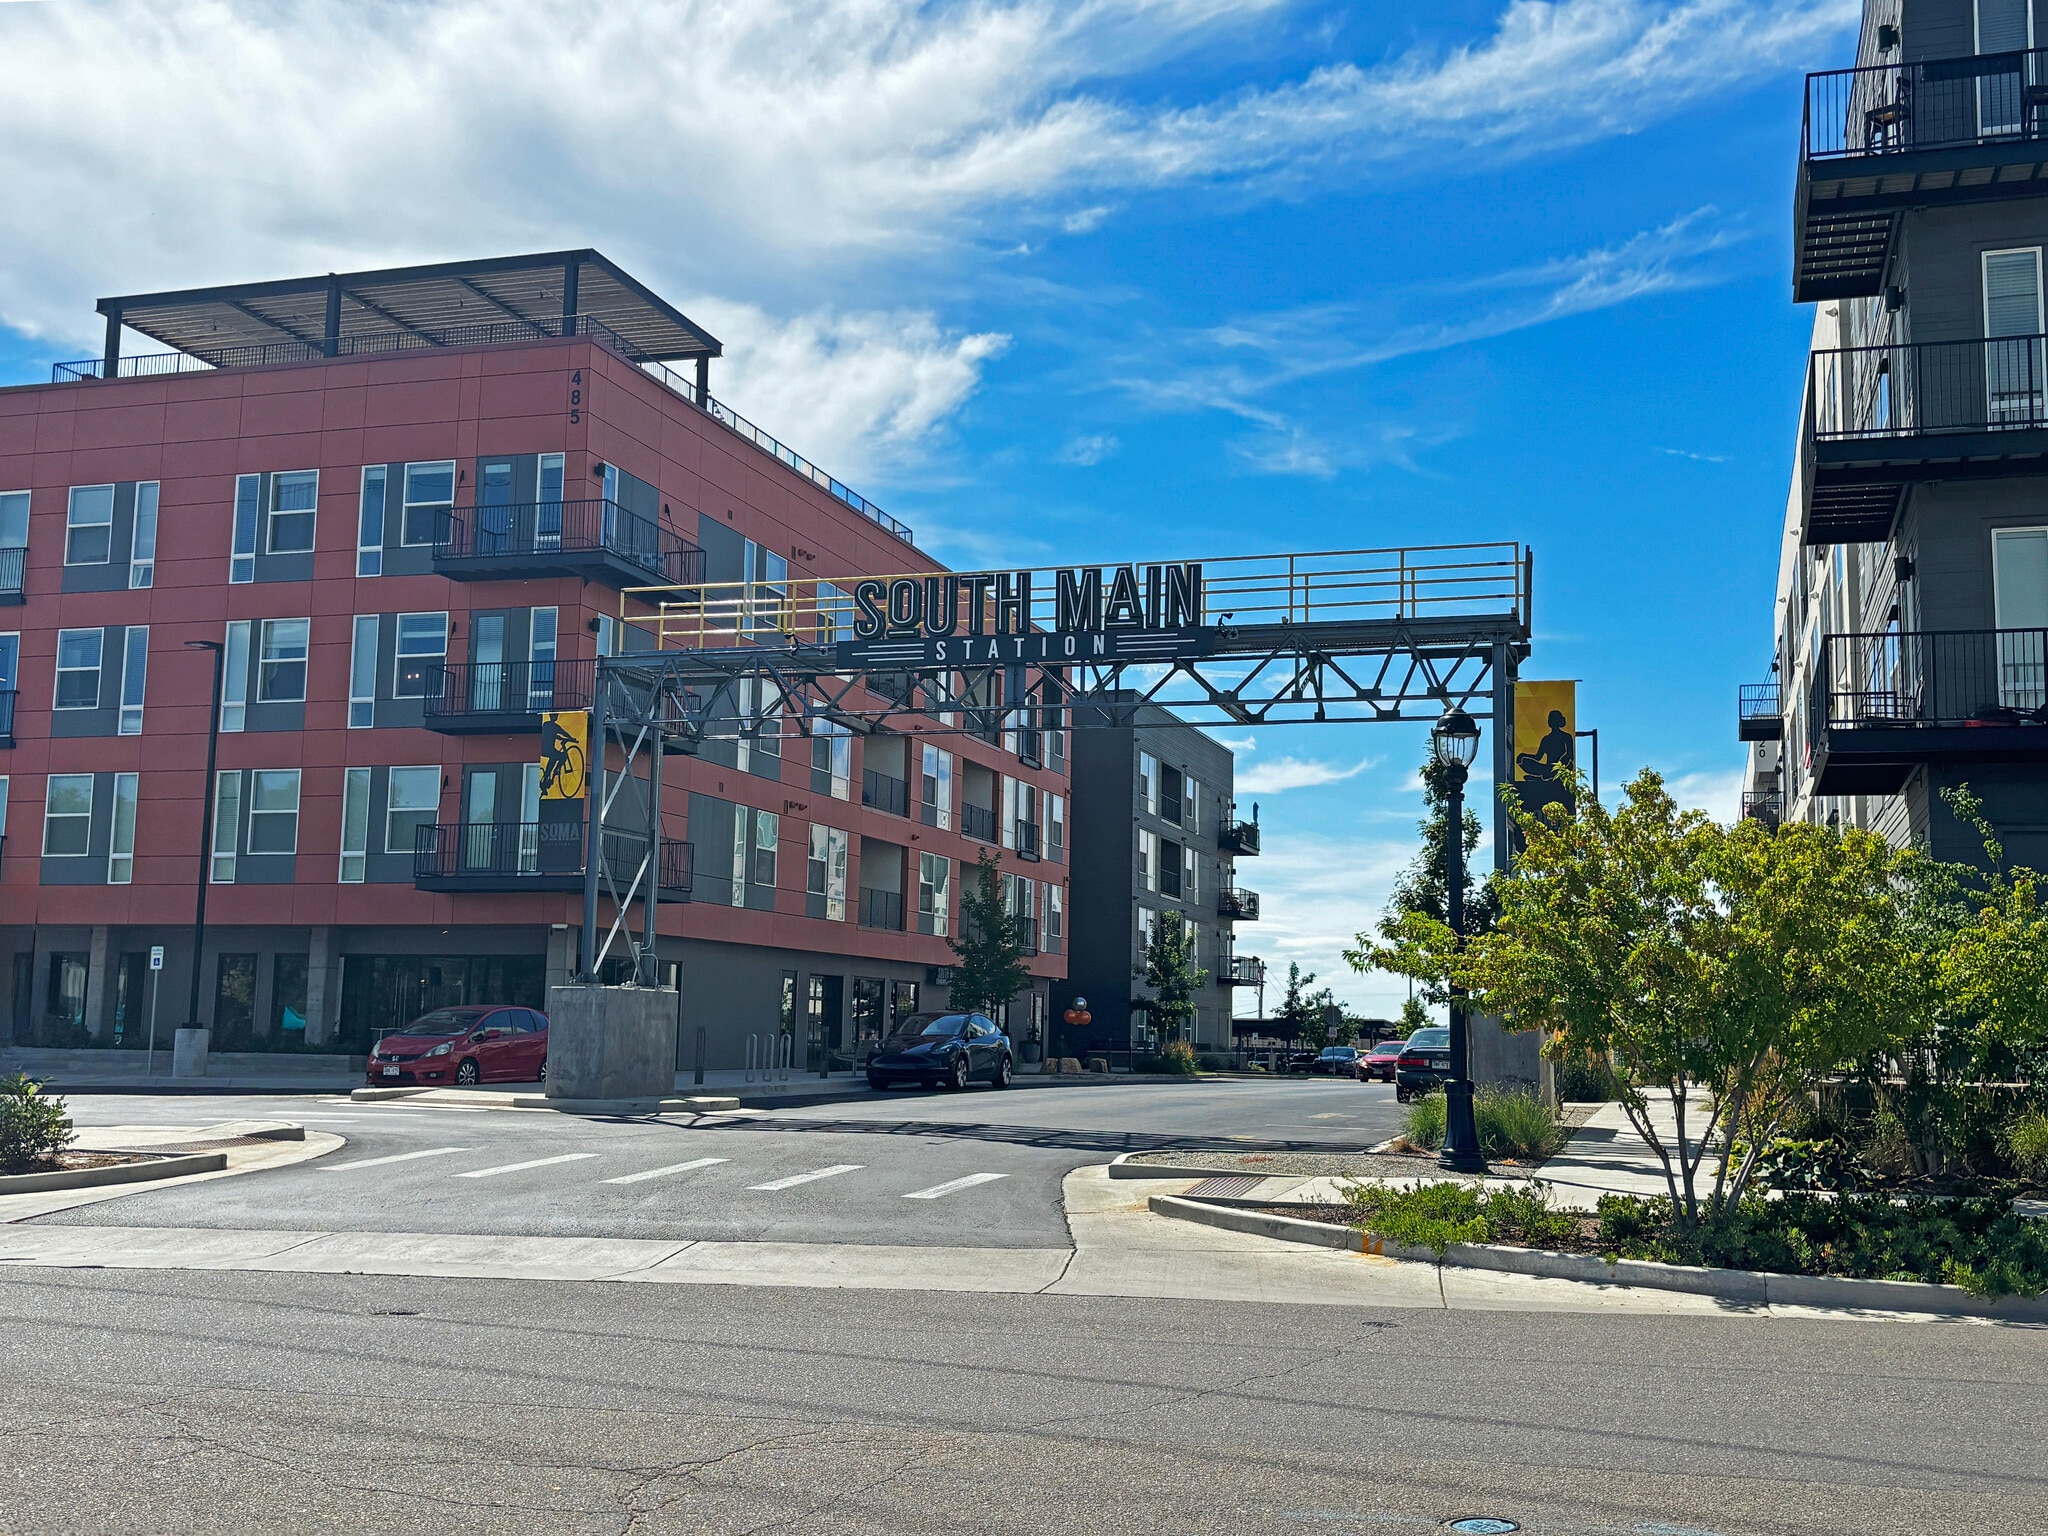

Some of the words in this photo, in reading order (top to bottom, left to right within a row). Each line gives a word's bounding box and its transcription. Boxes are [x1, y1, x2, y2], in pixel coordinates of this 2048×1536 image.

[570, 370, 582, 424] 485
[854, 572, 1031, 640] SOUTH
[1056, 564, 1202, 631] MAIN
[936, 634, 1105, 661] STATION
[540, 823, 580, 841] SOMA
